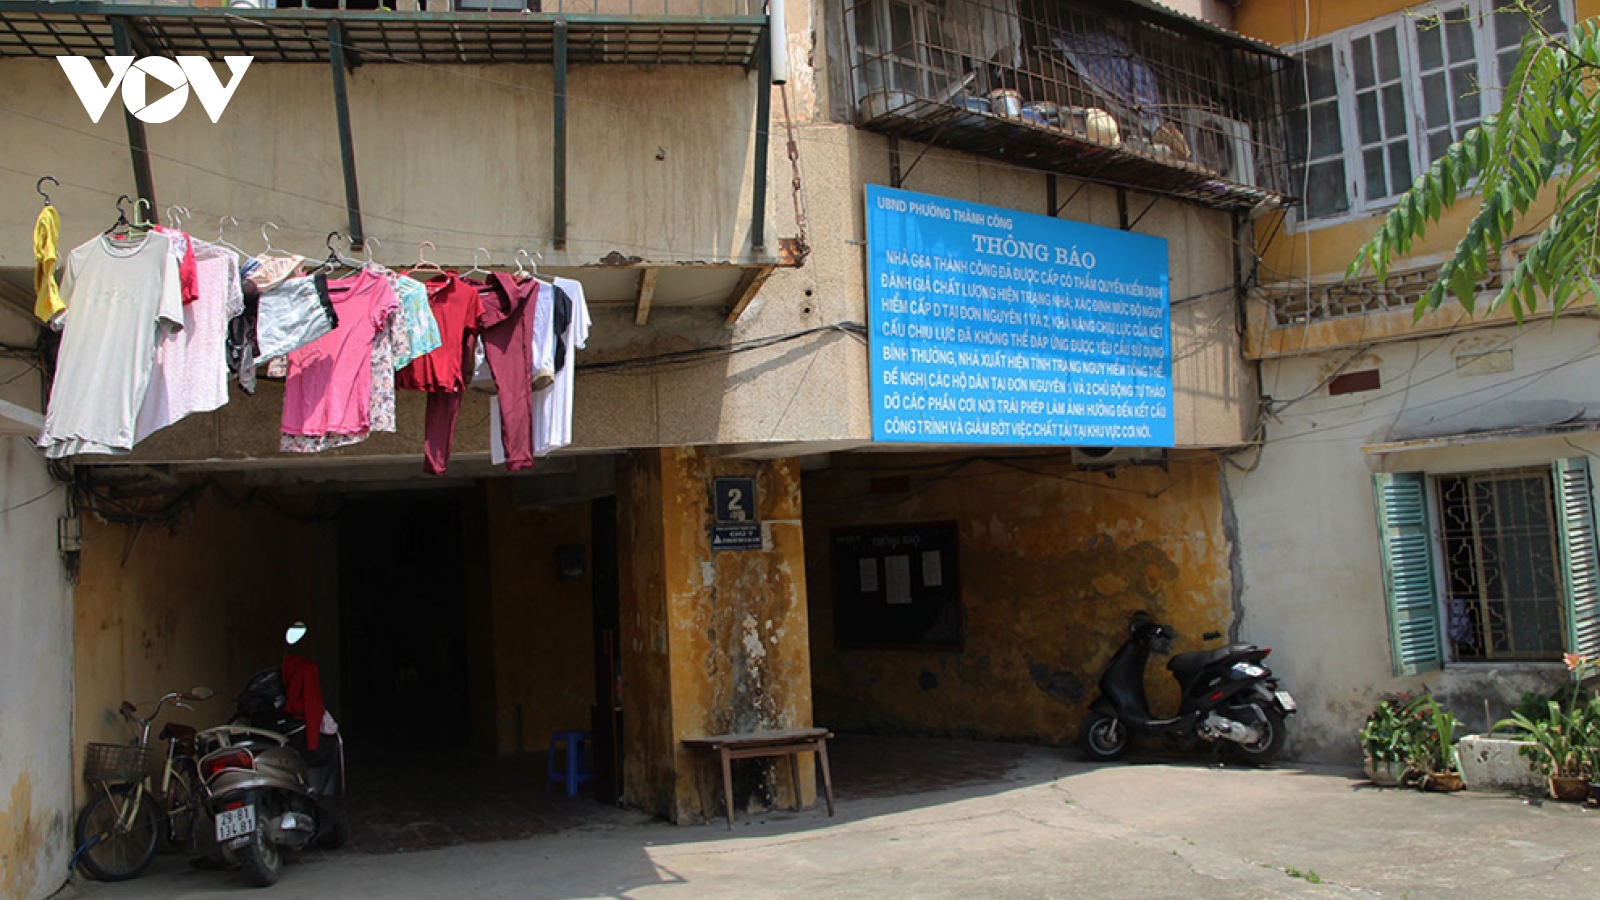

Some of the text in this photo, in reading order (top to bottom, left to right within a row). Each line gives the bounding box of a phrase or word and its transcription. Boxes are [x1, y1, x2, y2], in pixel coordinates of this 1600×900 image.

[877, 196, 1012, 230] UBND PHƯỜNG THÀNH CÔNG
[973, 234, 1096, 269] THÔNG BÁO
[886, 248, 909, 267] NHÀ
[911, 253, 931, 268] G6A
[933, 254, 968, 274] THÀNH
[970, 259, 997, 277] CÔNG
[999, 262, 1012, 279] ĐÃ
[1013, 267, 1039, 285] ĐƯỢC
[1041, 268, 1058, 285] CẤP
[1060, 271, 1073, 287] CÓ
[1145, 286, 1162, 301] ĐỊNH
[881, 271, 911, 290] ĐÁNH
[913, 275, 931, 292] GIÁ
[933, 277, 960, 295] CHẤT
[962, 283, 996, 301] LƯỢNG
[997, 285, 1019, 305] HIỆN
[1020, 290, 1050, 308] TRẠNG
[1074, 295, 1091, 310] XÁC
[1092, 299, 1110, 315] ĐỊNH
[1130, 301, 1141, 319] ĐỘ
[1142, 306, 1163, 318] NGUY
[910, 296, 931, 316] CẤP
[942, 304, 958, 321] TẠI
[960, 306, 981, 321] ĐƠN
[983, 308, 1021, 325] NGUYÊN
[1023, 313, 1028, 325] 1
[1029, 309, 1042, 326] VÀ
[1071, 316, 1094, 332] NĂNG
[1096, 321, 1114, 337] CHỊU
[1116, 323, 1131, 337] LỰC
[1133, 321, 1148, 337] CỦA
[1150, 323, 1163, 339] KẾT
[882, 317, 905, 337] CẤU
[908, 324, 933, 342] CHỊU
[935, 326, 955, 344] LỰC
[958, 326, 973, 343] ĐÃ
[974, 328, 1009, 346] KHÔNG
[1030, 332, 1049, 349] ĐÁP
[1071, 339, 1094, 355] ĐƯỢC
[1096, 339, 1112, 354] YÊU
[1143, 346, 1164, 360] DỤNG
[883, 342, 908, 361] BÌNH
[958, 349, 980, 366] NHÀ
[981, 350, 1006, 368] XUẤT
[1008, 353, 1029, 372] HIỆN
[1030, 353, 1050, 371] TÌNH
[1052, 358, 1081, 376] TRẠNG
[1083, 362, 1104, 375] NGUY
[901, 371, 927, 390] NGHỊ
[929, 370, 950, 388] CÁC
[952, 371, 967, 392] HỘ
[969, 373, 989, 389] DÂN
[991, 376, 1006, 394] TẠI
[1008, 377, 1028, 392] ĐƠN
[1029, 377, 1065, 393] NGUYÊN
[1067, 381, 1072, 394] 1
[1073, 378, 1084, 394] VÀ
[1086, 382, 1091, 395] 2
[1092, 379, 1109, 396] CHỦ
[1111, 380, 1133, 400] ĐỘNG
[1134, 384, 1144, 400] TỰ
[903, 392, 925, 410] CÁC
[997, 397, 1018, 413] TRÁI
[1020, 397, 1044, 414] PHÉP
[1047, 398, 1065, 415] LÀM
[1066, 398, 1084, 416] ẢNH
[1117, 400, 1133, 417] ĐẾN
[1134, 401, 1149, 418] KẾT
[1151, 402, 1166, 418] CẤU
[884, 416, 916, 434] CÔNG
[918, 416, 948, 434] TRÌNH
[950, 416, 963, 434] VÀ
[991, 418, 1010, 436] BỚT
[1011, 419, 1032, 439] VIỆC
[1033, 419, 1057, 436] CHẤT
[1073, 424, 1086, 440] TẠI
[1087, 425, 1103, 438] KHU
[1104, 424, 1120, 441] VỰC
[728, 488, 742, 511] 2
